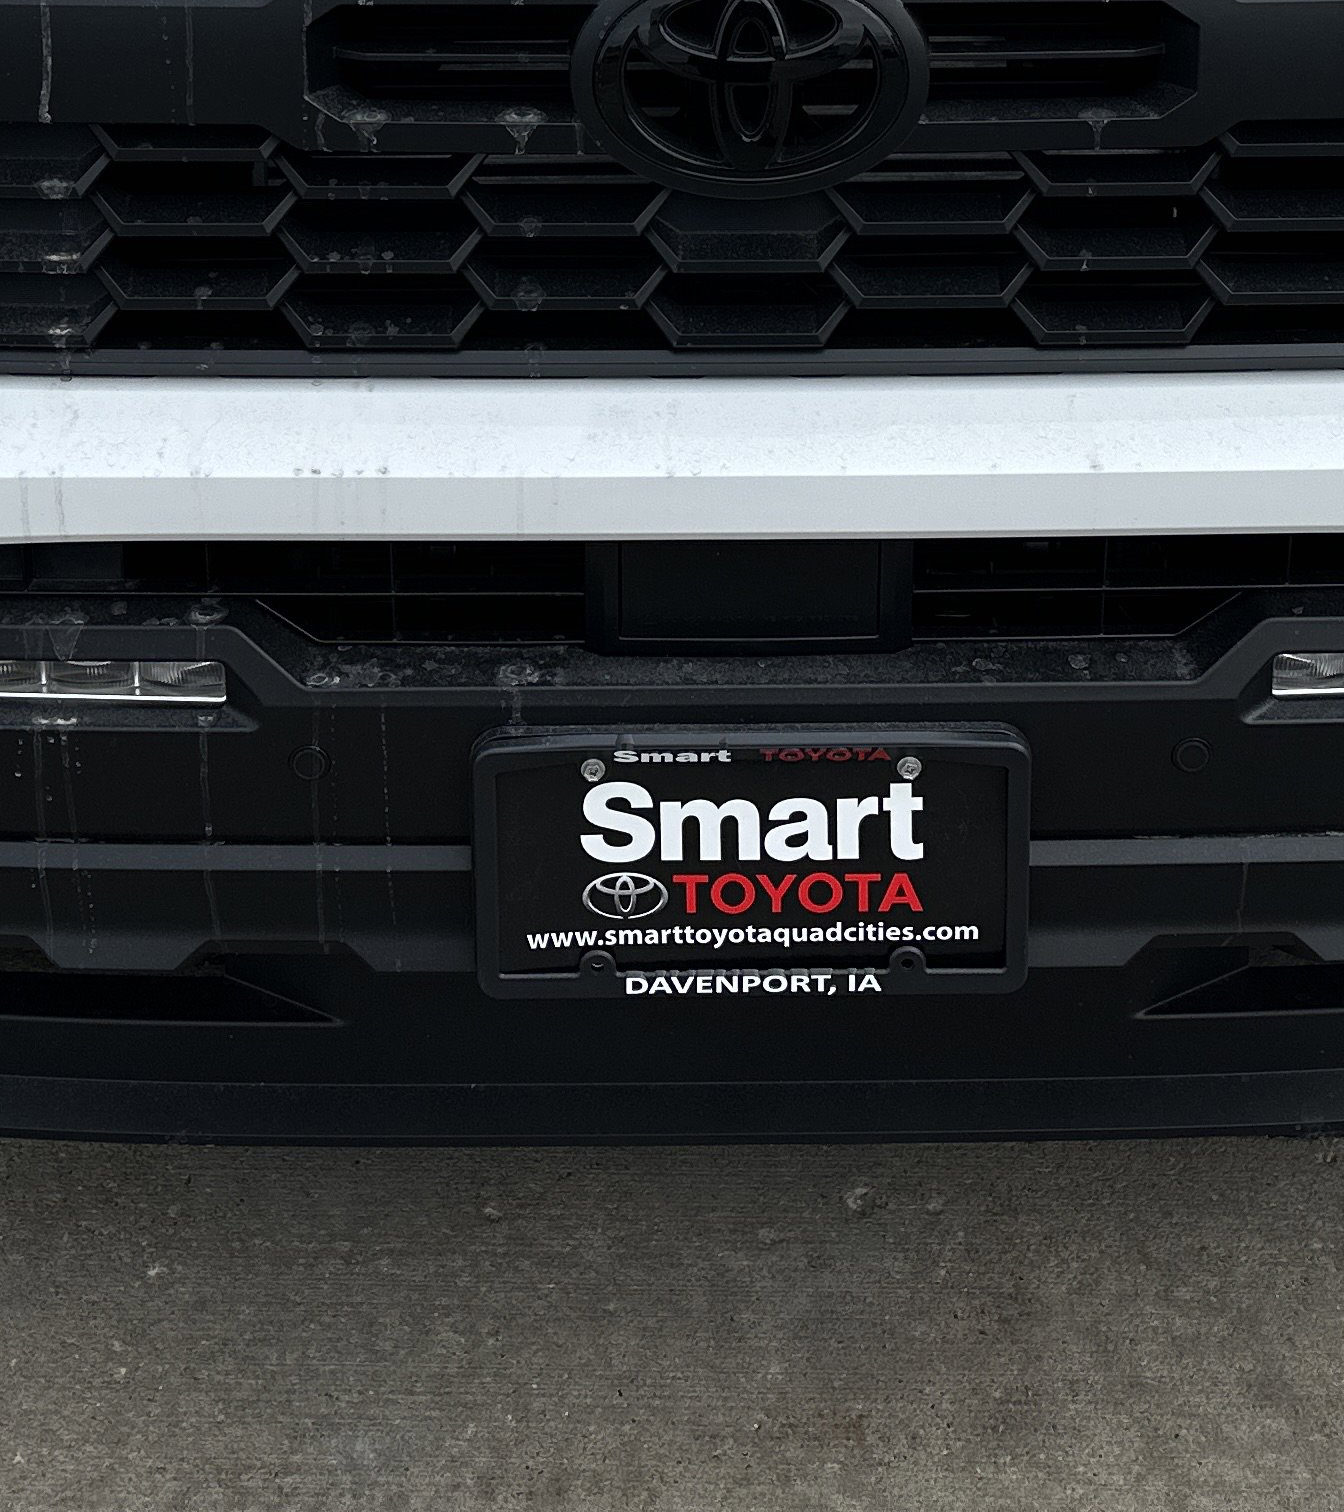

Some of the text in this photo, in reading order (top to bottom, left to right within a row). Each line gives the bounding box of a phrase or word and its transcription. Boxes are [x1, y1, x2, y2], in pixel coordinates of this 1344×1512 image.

[613, 747, 892, 763] Smart TOYOTA
[579, 781, 924, 863] Smart
[672, 872, 924, 914] TOYOTA
[526, 921, 979, 950] www.smarttoyotaquadcities.com
[625, 973, 882, 996] DAVENPORT, IA
